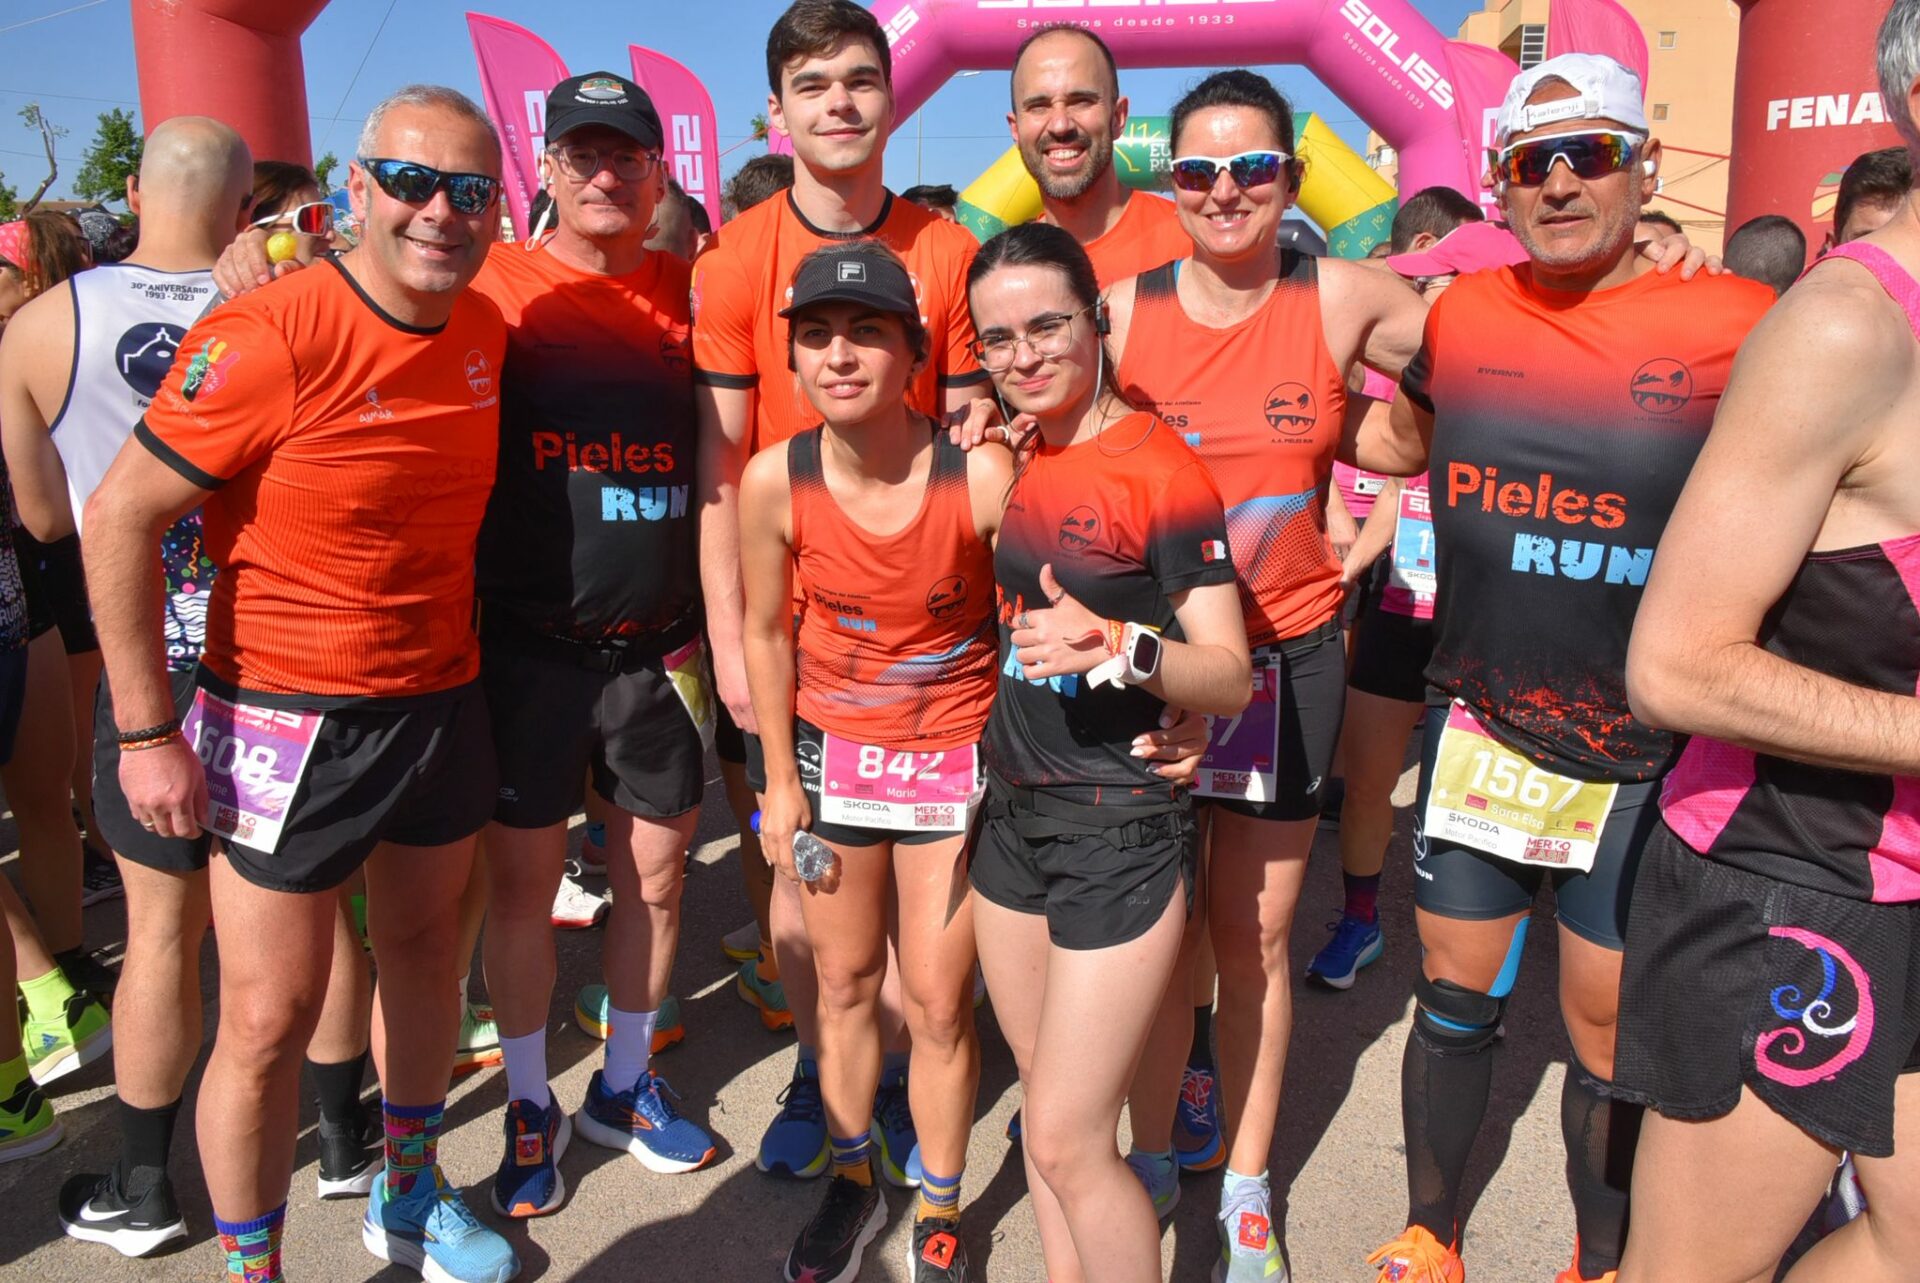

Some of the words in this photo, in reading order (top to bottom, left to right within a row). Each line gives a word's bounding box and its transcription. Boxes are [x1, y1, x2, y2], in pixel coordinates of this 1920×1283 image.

[1113, 16, 1175, 26] desde
[1188, 15, 1235, 25] 1933
[1339, 0, 1455, 110] SOLISS
[1342, 31, 1377, 66] Seguros
[1377, 66, 1403, 91] desde
[148, 284, 208, 294] ANIVERSARIO
[172, 293, 195, 301] 2023
[532, 431, 676, 474] Pieles
[601, 484, 689, 522] RUN
[1447, 461, 1628, 530] Pieles
[1511, 532, 1654, 586] RUN
[813, 591, 863, 616] Pieles
[837, 616, 877, 632] RUN
[192, 720, 279, 786] 1608
[857, 745, 945, 781] 842
[1470, 750, 1584, 813] 1567
